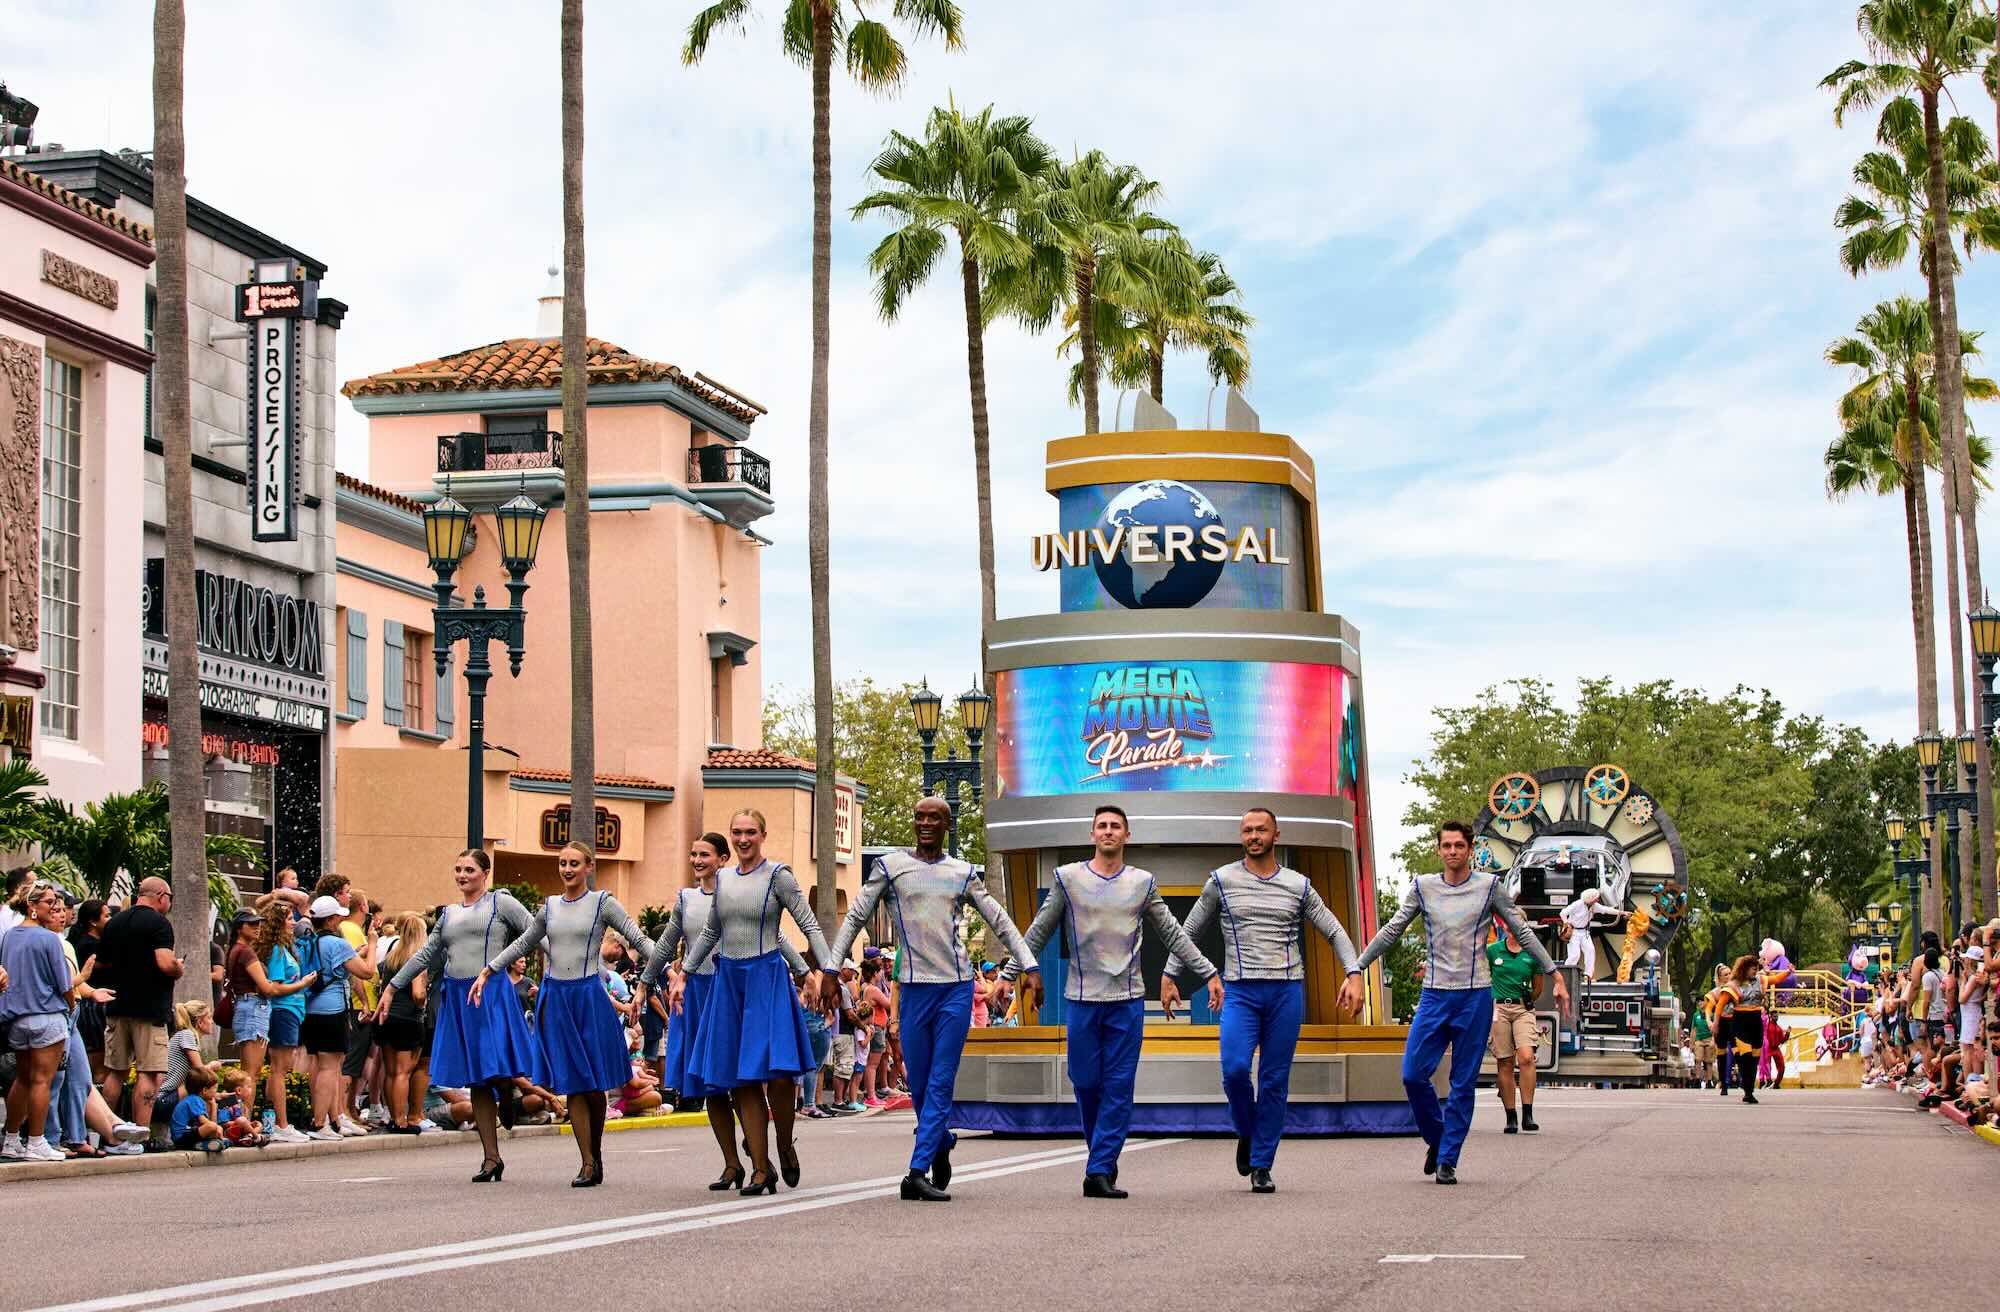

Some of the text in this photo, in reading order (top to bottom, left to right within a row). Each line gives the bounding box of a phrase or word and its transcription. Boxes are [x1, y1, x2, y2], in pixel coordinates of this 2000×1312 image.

[264, 328, 281, 523] PROCESSING
[1030, 525, 1290, 572] UNIVERSAL
[164, 559, 324, 676] RKROOM
[1088, 666, 1203, 704] MEGA
[1081, 696, 1216, 740] MOVIE
[1085, 728, 1184, 776] Parade
[546, 816, 616, 848] THER
